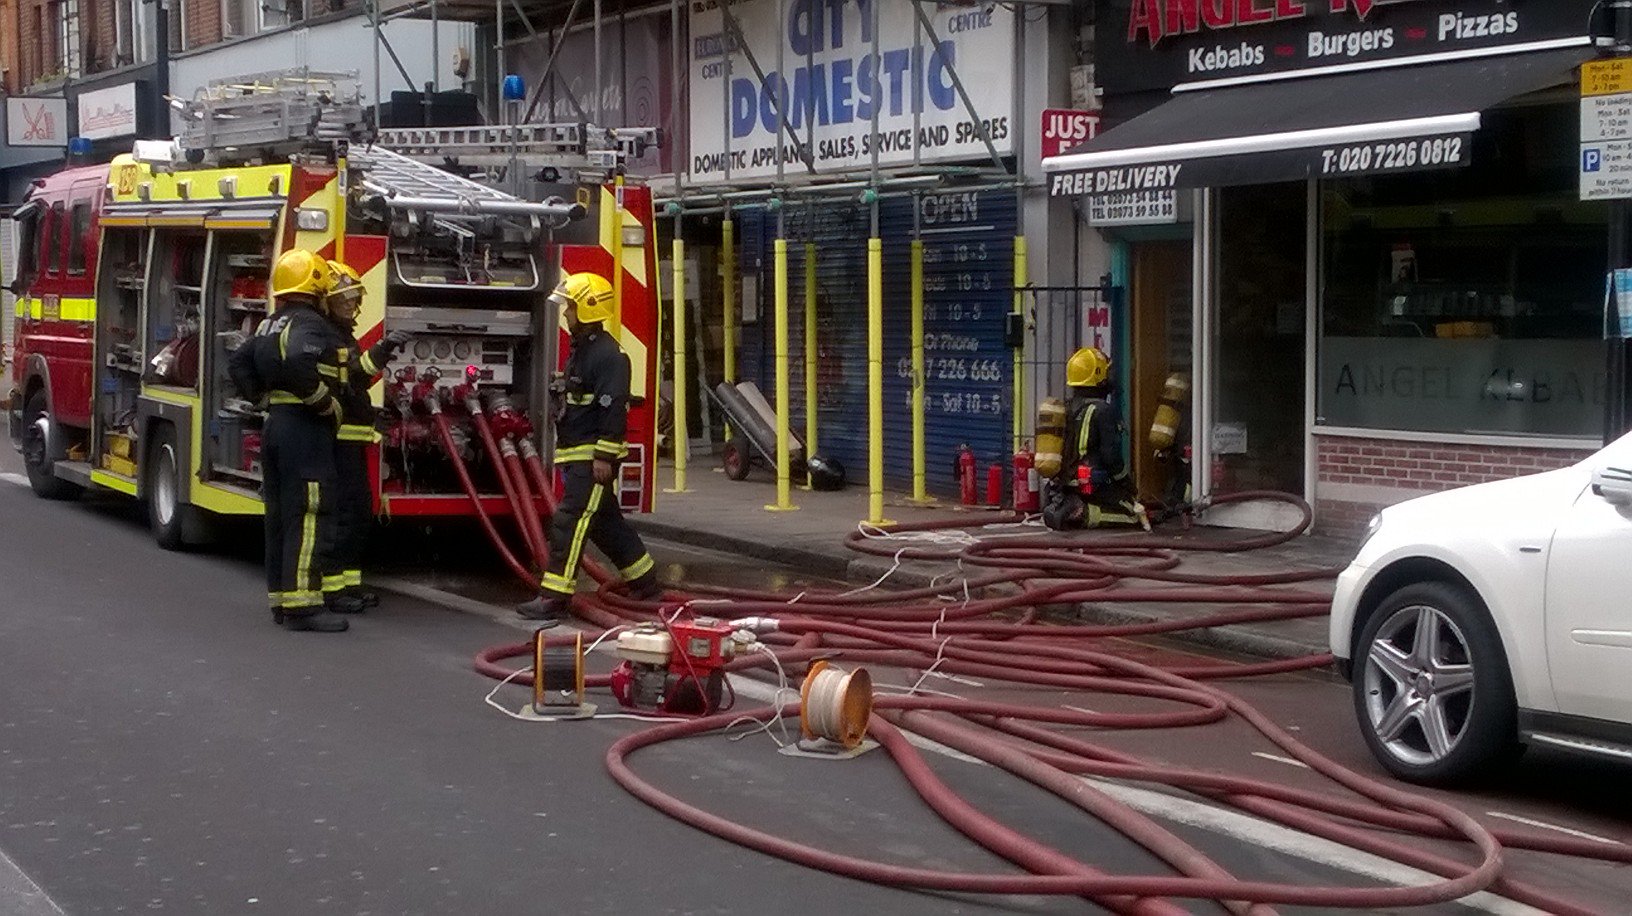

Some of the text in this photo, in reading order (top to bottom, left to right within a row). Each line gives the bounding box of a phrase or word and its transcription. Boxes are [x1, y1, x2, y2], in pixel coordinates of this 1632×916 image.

[1188, 12, 1519, 73] Kebabs Burgers Pizzas
[732, 40, 955, 138] DOMESTIC
[1045, 114, 1100, 140] JUST
[694, 150, 746, 174] DOMETIC
[819, 136, 859, 160] SALES,
[862, 129, 911, 155] SRVICE
[919, 124, 949, 149] AND
[1321, 136, 1462, 174] T: 020 7226 0812
[1587, 151, 1598, 170] P
[1051, 163, 1182, 196] FREE DELIVERY
[921, 192, 978, 223] OPEN
[1092, 207, 1105, 219] TEL
[938, 358, 967, 380] 226
[971, 359, 1001, 381] 666
